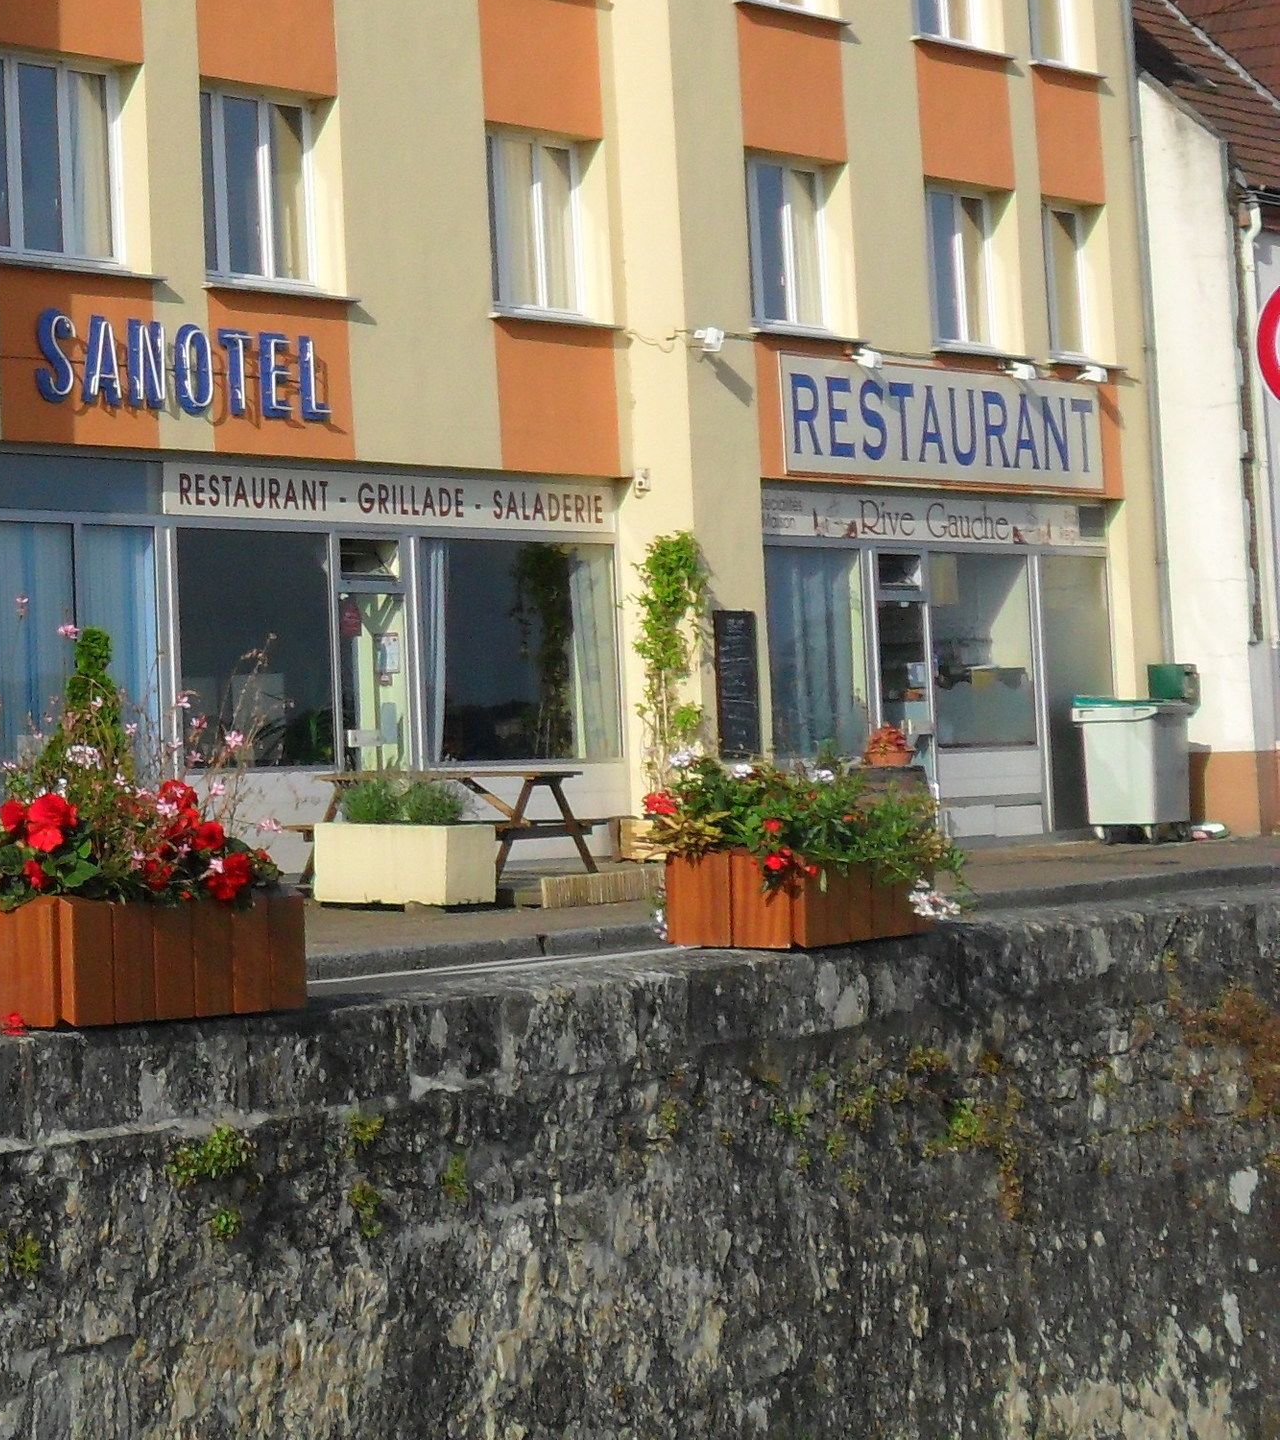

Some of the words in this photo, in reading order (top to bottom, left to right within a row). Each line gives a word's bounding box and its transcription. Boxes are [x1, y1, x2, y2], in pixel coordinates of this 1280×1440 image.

[35, 307, 331, 422] SANOTEL
[789, 372, 1094, 474] RESTAURANT
[179, 472, 329, 514] RESTAURANT
[358, 481, 465, 519] GRILLADE
[493, 487, 604, 525] SALADERIE
[859, 499, 915, 536] Rive
[926, 502, 1010, 541] Gauche
